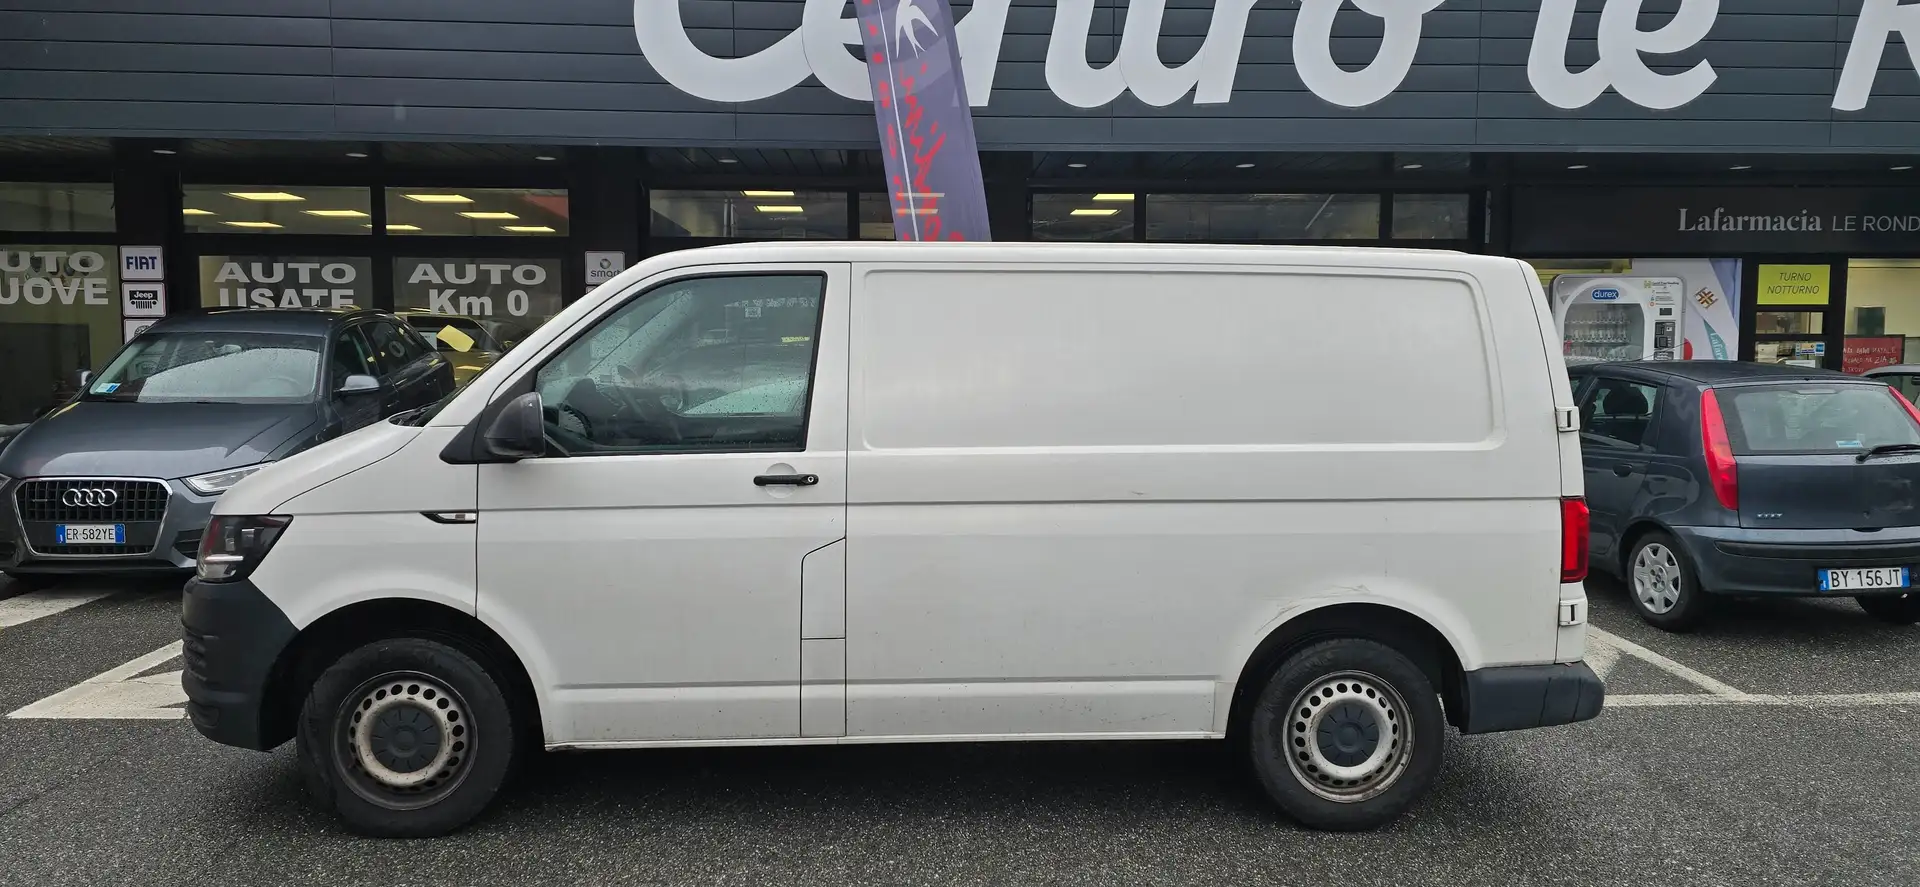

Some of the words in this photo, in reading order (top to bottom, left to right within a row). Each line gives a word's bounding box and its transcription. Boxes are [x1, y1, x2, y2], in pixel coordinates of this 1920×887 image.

[1678, 207, 1822, 232] Lafarmacia
[1832, 215, 1856, 232] LE
[126, 256, 157, 270] FIAT
[214, 262, 356, 284] AUTO
[408, 263, 547, 285] AUTO
[1779, 272, 1812, 281] TURNO
[134, 291, 153, 300] Jeep
[1594, 290, 1617, 298] durex
[1767, 285, 1819, 294] NOTTURNO
[219, 288, 354, 309] USATE
[428, 288, 492, 316] Km
[507, 289, 529, 317] 0
[66, 528, 79, 541] ER
[82, 528, 115, 541] 582YE
[1831, 570, 1849, 588] BY
[1857, 569, 1901, 587] 156JT
